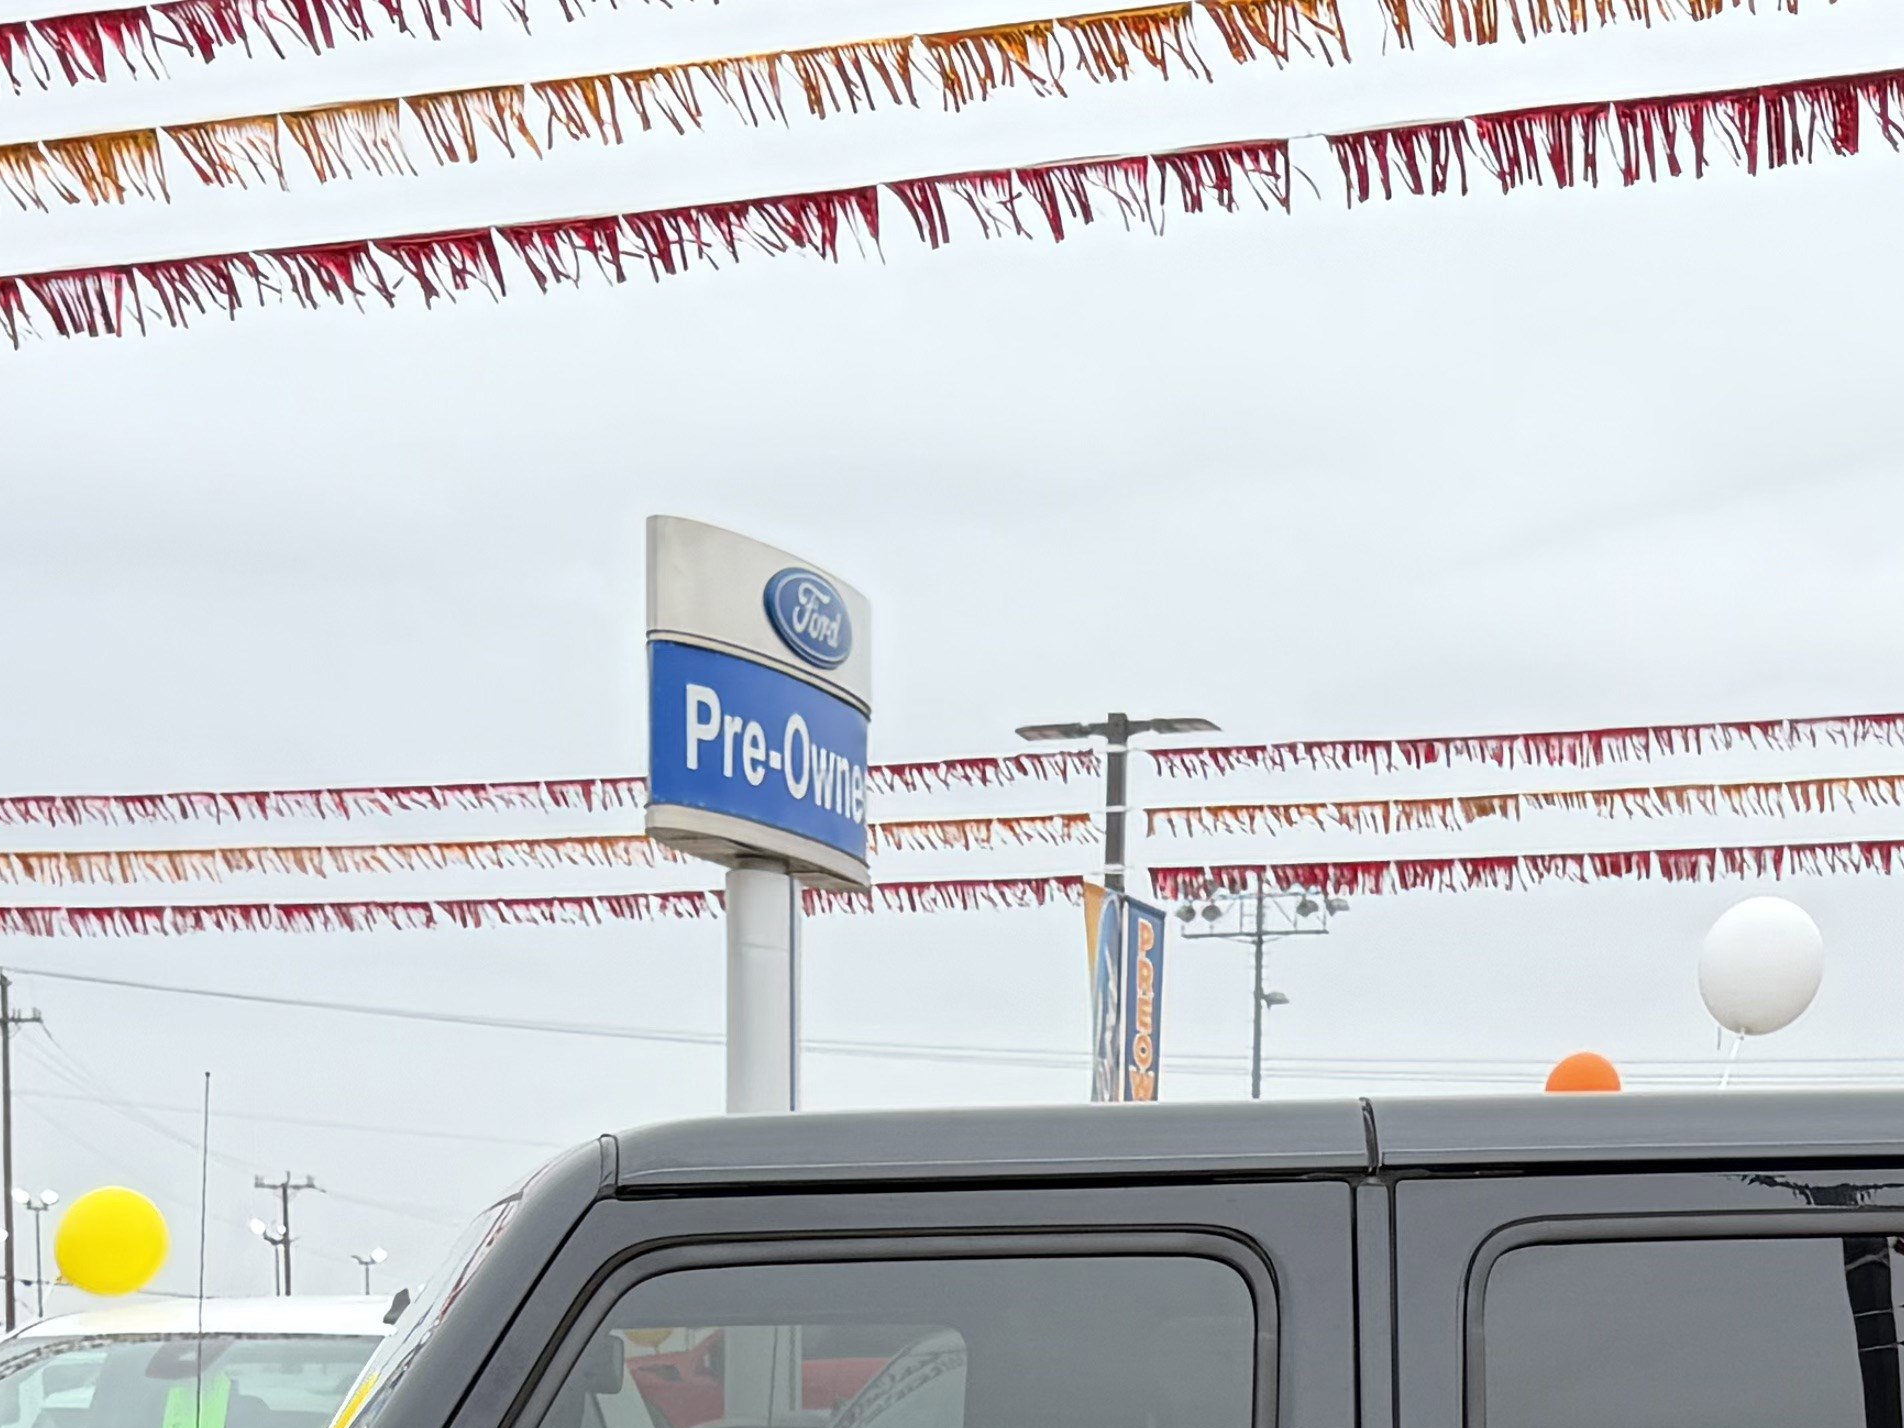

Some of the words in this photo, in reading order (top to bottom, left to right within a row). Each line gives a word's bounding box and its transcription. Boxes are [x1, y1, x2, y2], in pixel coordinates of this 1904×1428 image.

[792, 581, 842, 648] Ford
[685, 683, 866, 824] Pre-Owne
[1126, 918, 1155, 1101] PREOW
